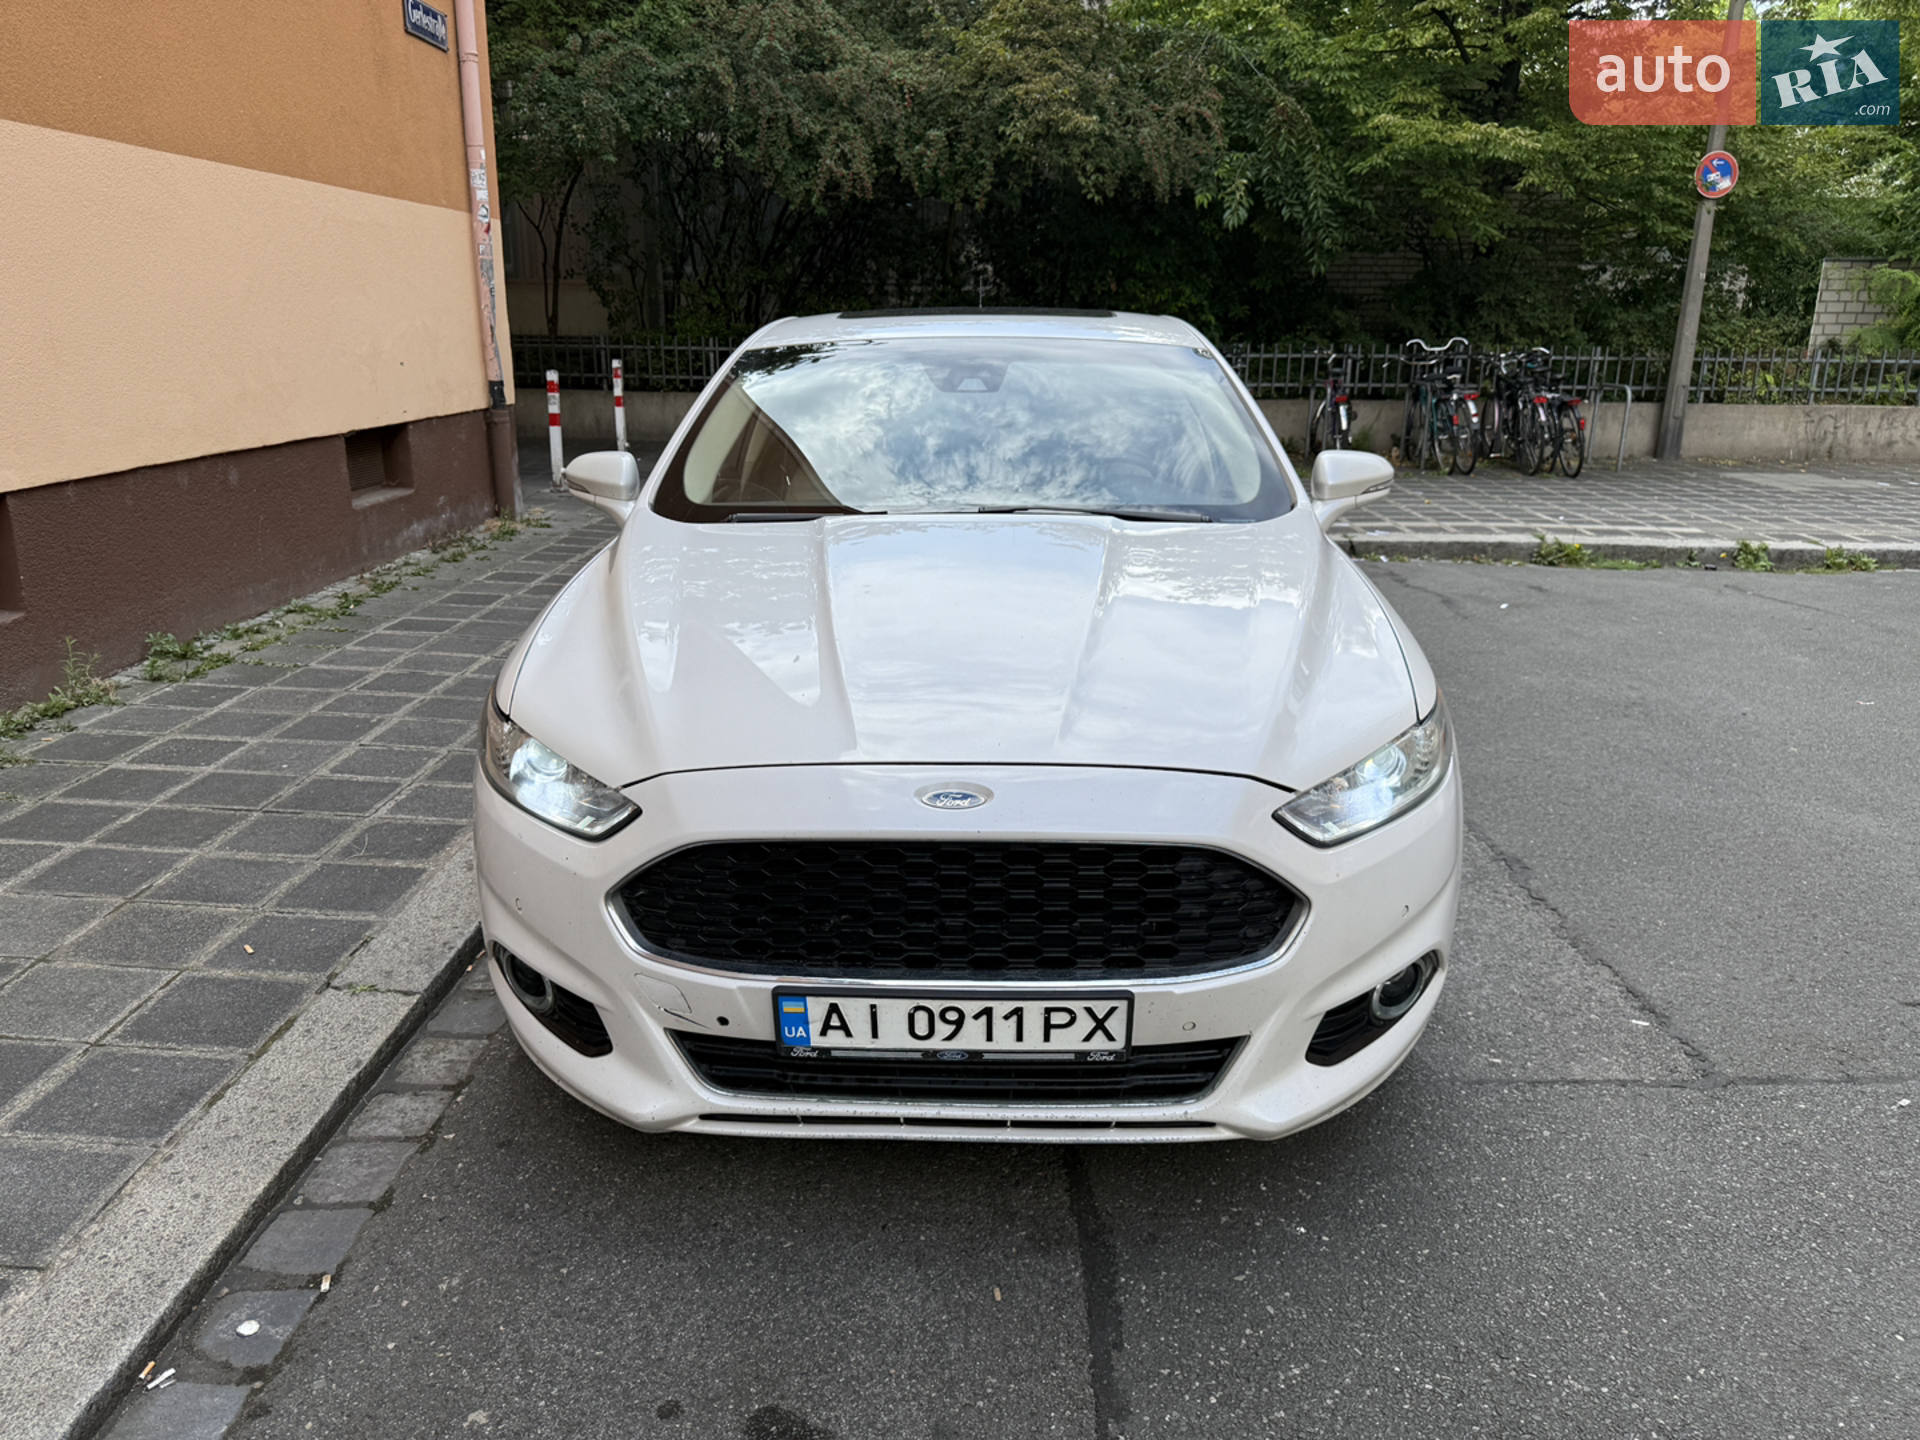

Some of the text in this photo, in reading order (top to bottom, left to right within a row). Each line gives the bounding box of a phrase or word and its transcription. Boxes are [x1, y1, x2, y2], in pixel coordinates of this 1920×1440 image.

[936, 794, 971, 806] Ford
[819, 1002, 1120, 1043] AI 0911 PX
[784, 1026, 807, 1038] UA
[790, 1046, 819, 1058] Ford
[1087, 1051, 1116, 1062] Ford
